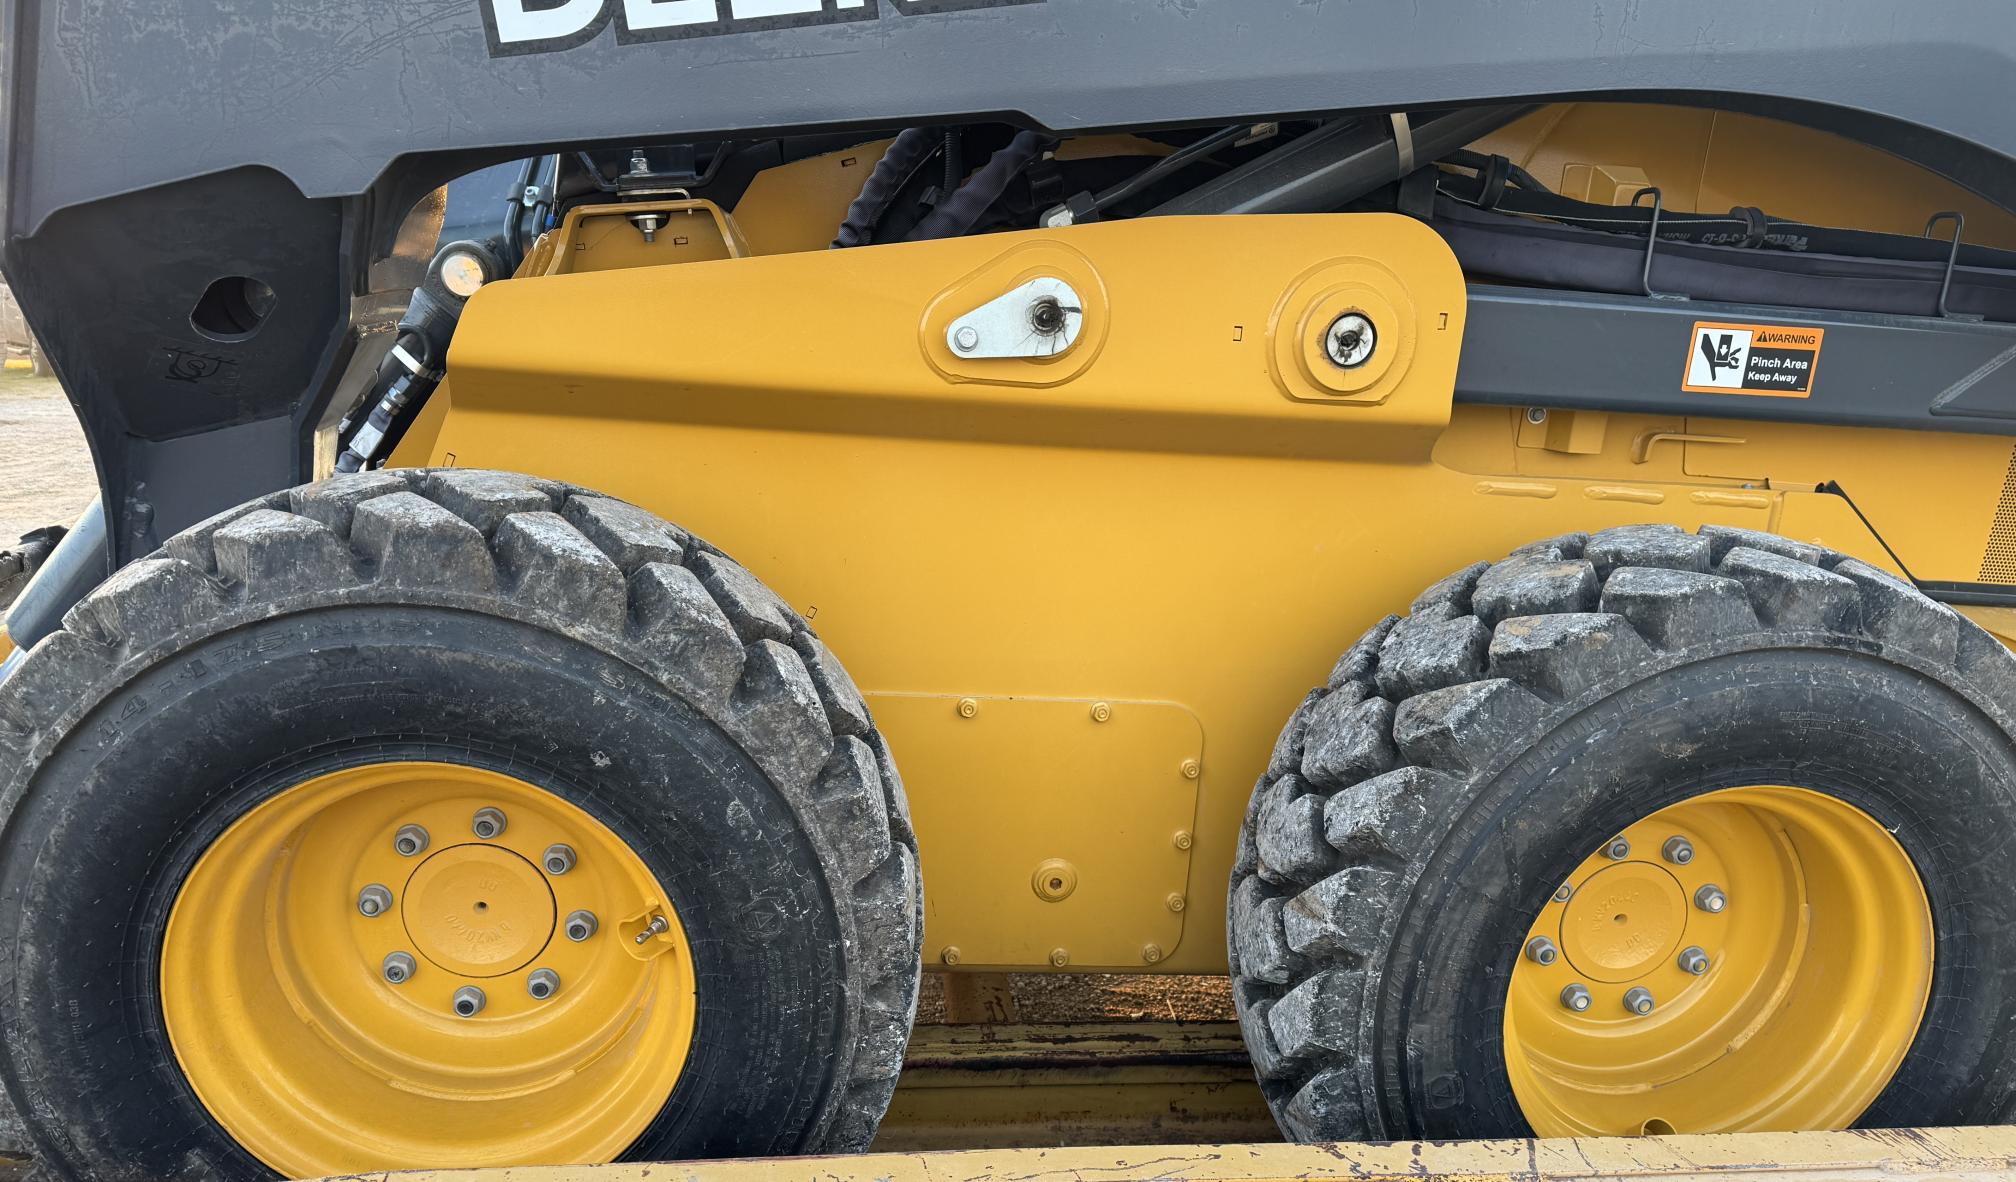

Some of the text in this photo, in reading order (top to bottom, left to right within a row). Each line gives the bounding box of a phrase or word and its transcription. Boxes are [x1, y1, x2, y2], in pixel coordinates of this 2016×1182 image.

[1768, 333, 1816, 345] WARNING
[1750, 356, 1808, 370] Pinch Area
[1747, 371, 1798, 385] Keep Away
